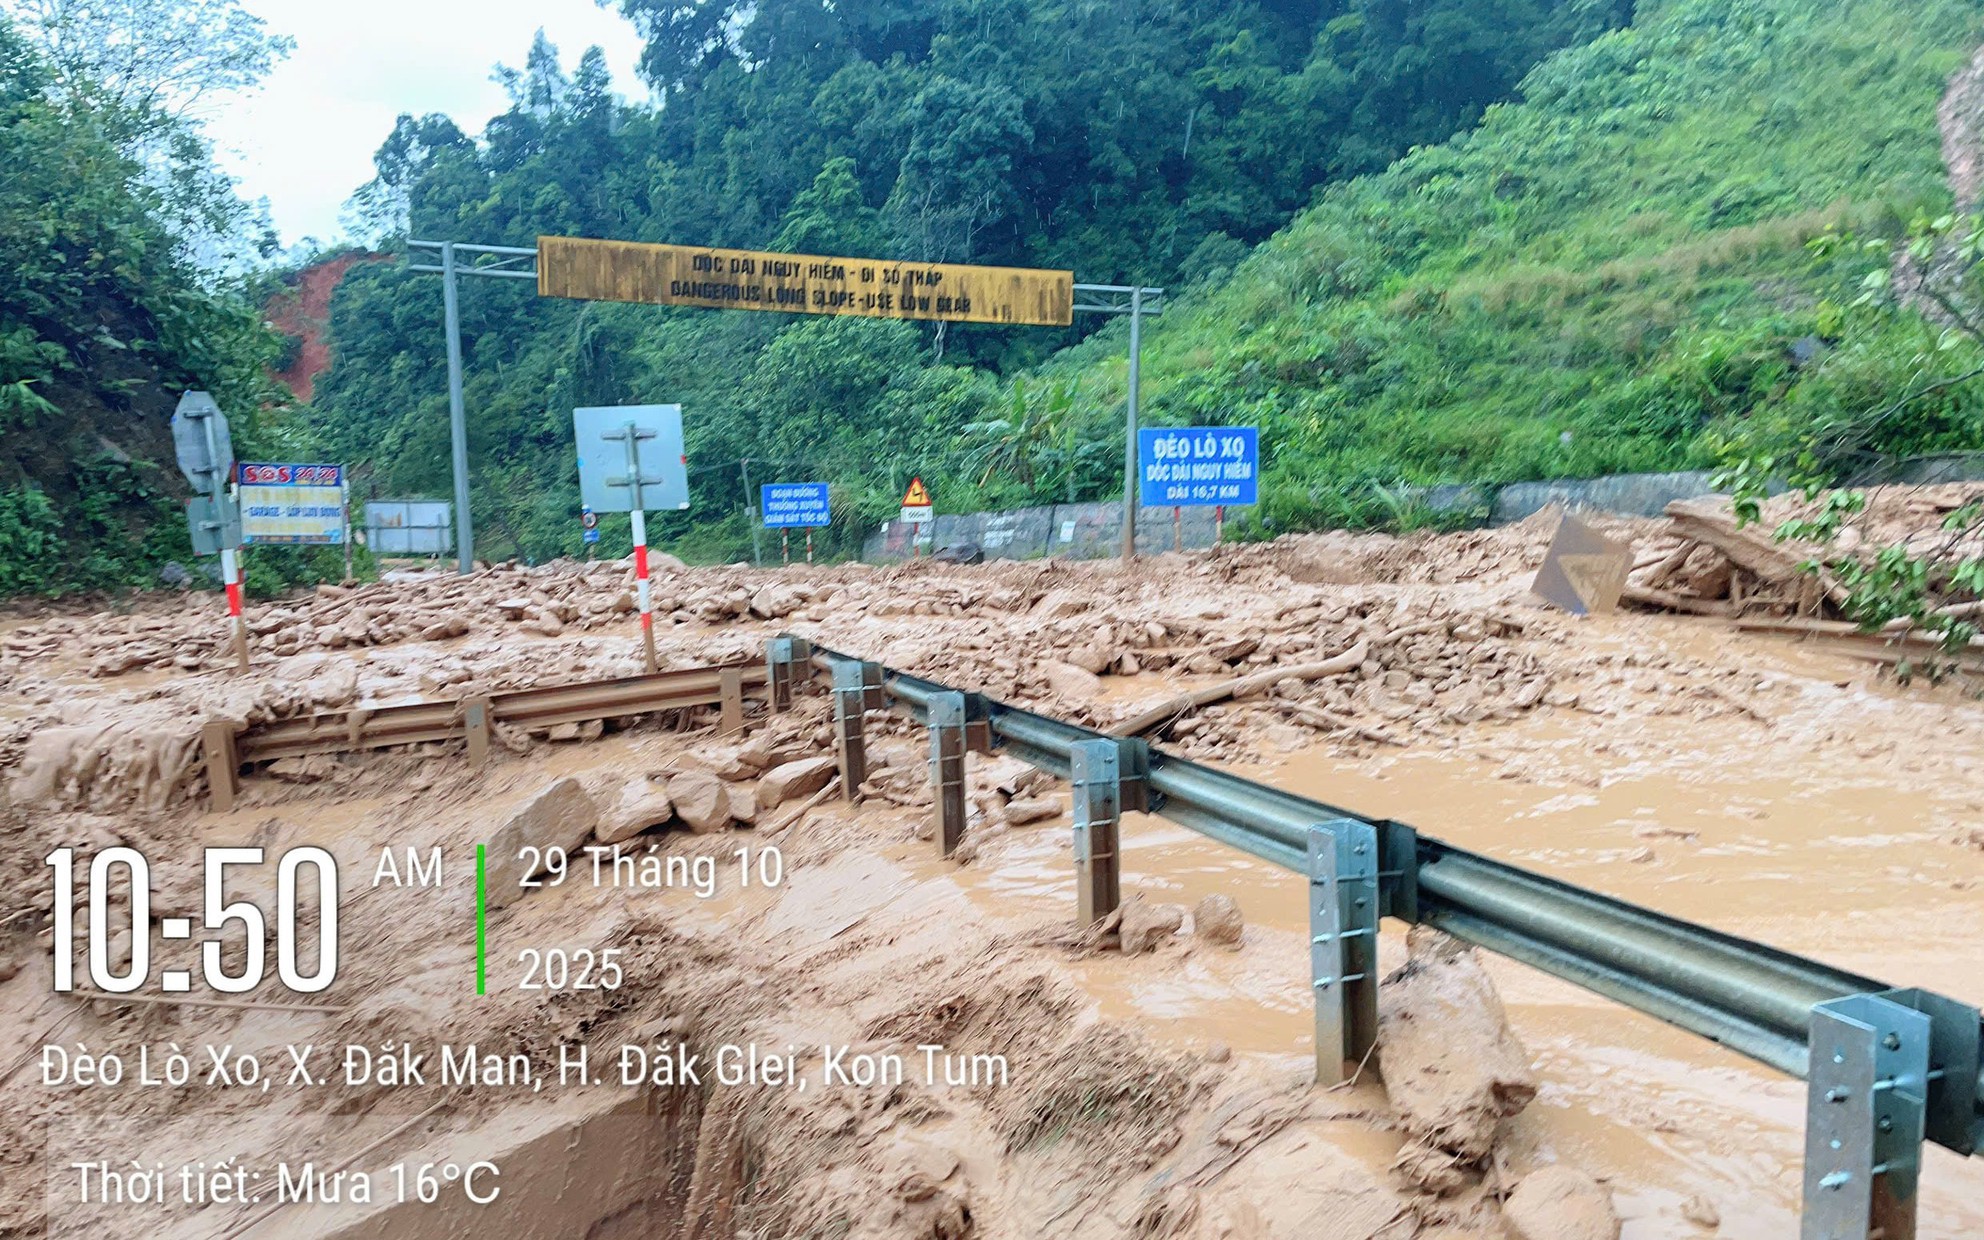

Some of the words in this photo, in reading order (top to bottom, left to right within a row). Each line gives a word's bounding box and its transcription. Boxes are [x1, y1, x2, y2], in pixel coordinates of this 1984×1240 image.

[671, 279, 760, 302] DANGEROUS
[768, 286, 806, 305] LONG
[900, 294, 930, 312] LOW
[936, 297, 971, 314] GEAR
[243, 465, 292, 484] SOS
